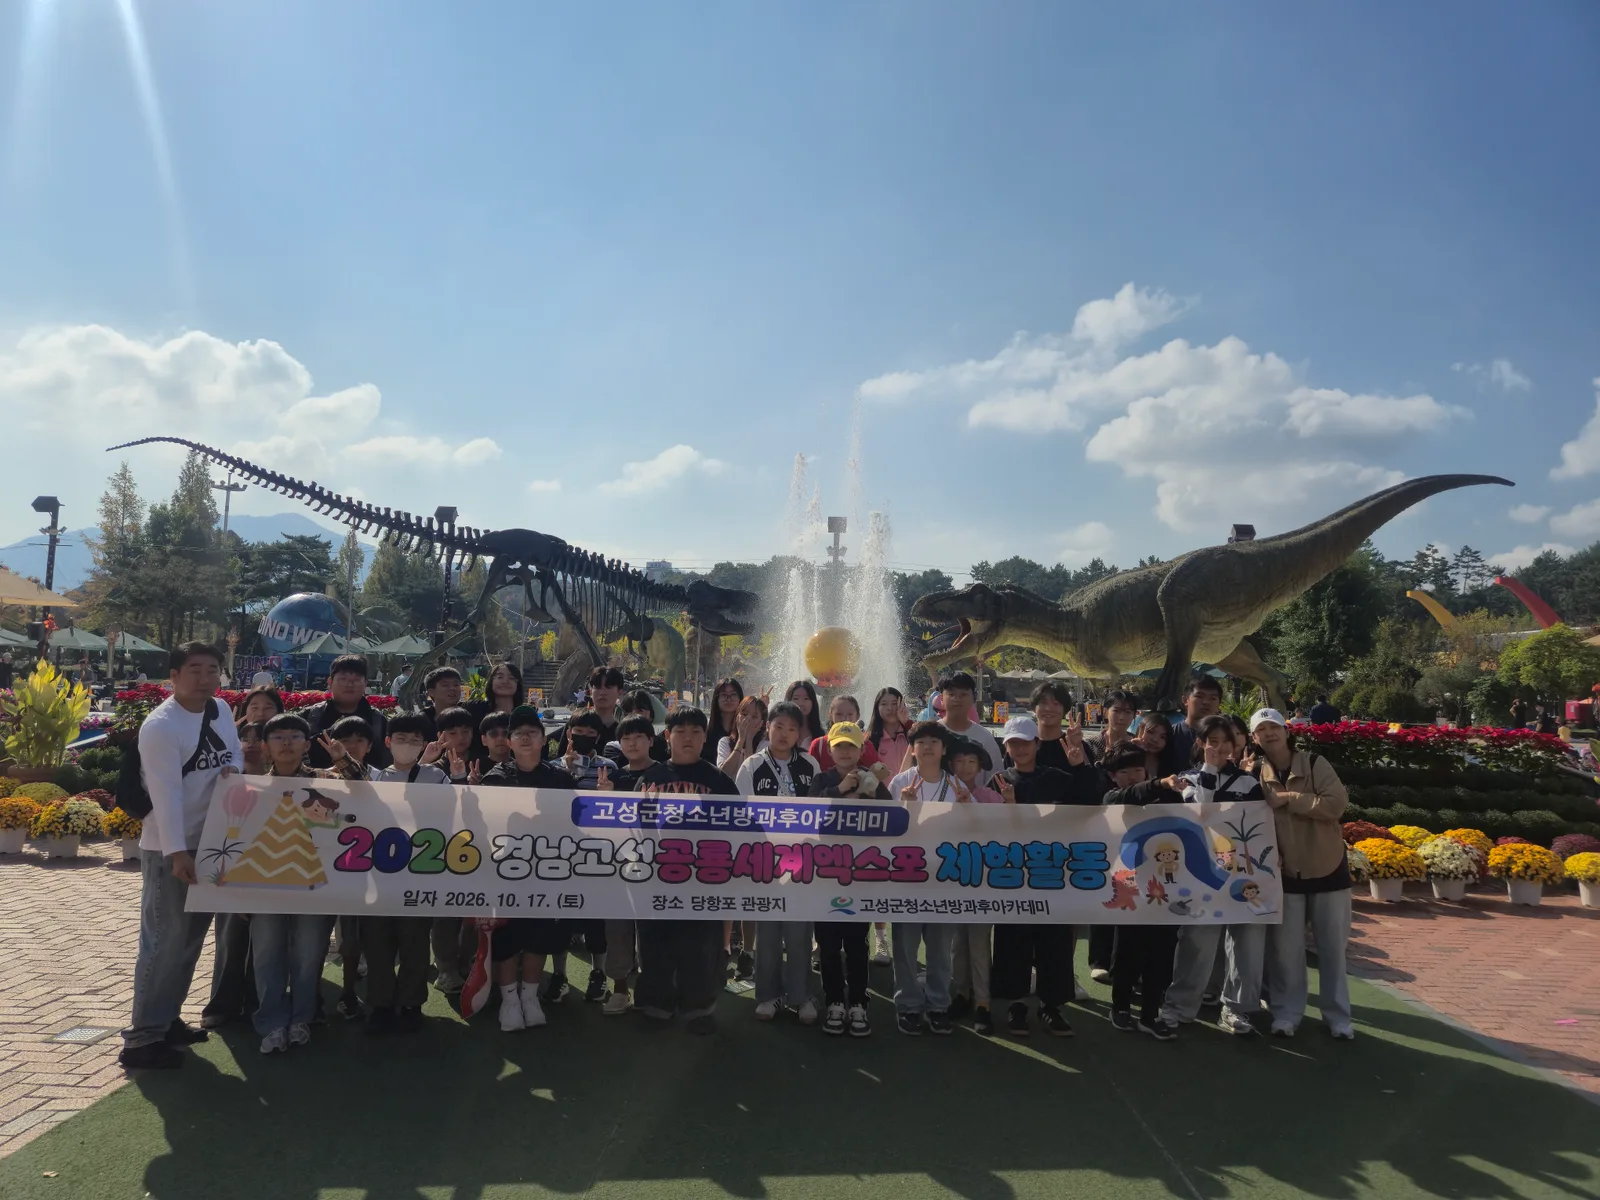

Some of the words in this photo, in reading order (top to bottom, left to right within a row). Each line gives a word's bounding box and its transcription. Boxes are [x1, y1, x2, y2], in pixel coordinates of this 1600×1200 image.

[592, 801, 889, 832] 고성군청소년방과후아카데미
[333, 826, 482, 875] 2026
[491, 834, 929, 886] 경남고성공룡세계엑스포
[936, 840, 1111, 890] 체험활동
[403, 889, 437, 907] 일자
[445, 892, 490, 907] 2026.
[498, 893, 520, 907] 10.
[528, 894, 550, 908] 17.
[557, 893, 585, 909] (토)
[652, 894, 684, 911] 장소
[691, 895, 738, 912] 당항포
[741, 896, 787, 913] 관광지
[859, 898, 1050, 916] 고성군청소년방과후아카데미
